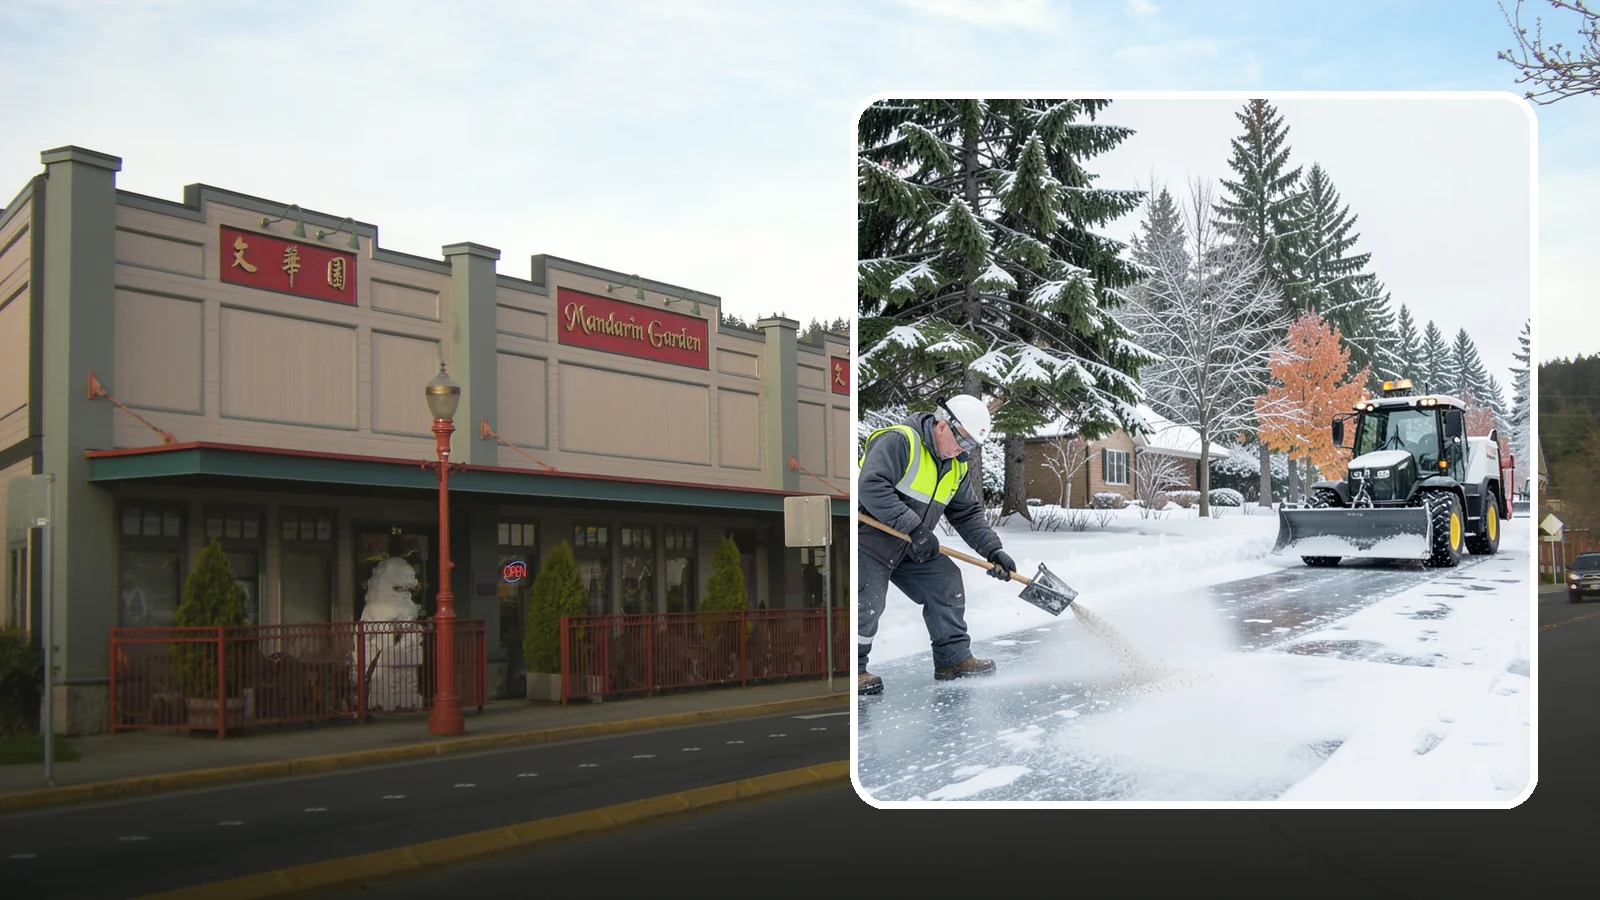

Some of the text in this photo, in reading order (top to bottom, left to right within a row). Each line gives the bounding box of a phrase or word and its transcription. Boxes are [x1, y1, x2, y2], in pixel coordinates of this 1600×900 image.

[231, 236, 346, 291] 文華園
[565, 302, 701, 352] Mandarin Garden
[503, 565, 527, 578] OPEN
